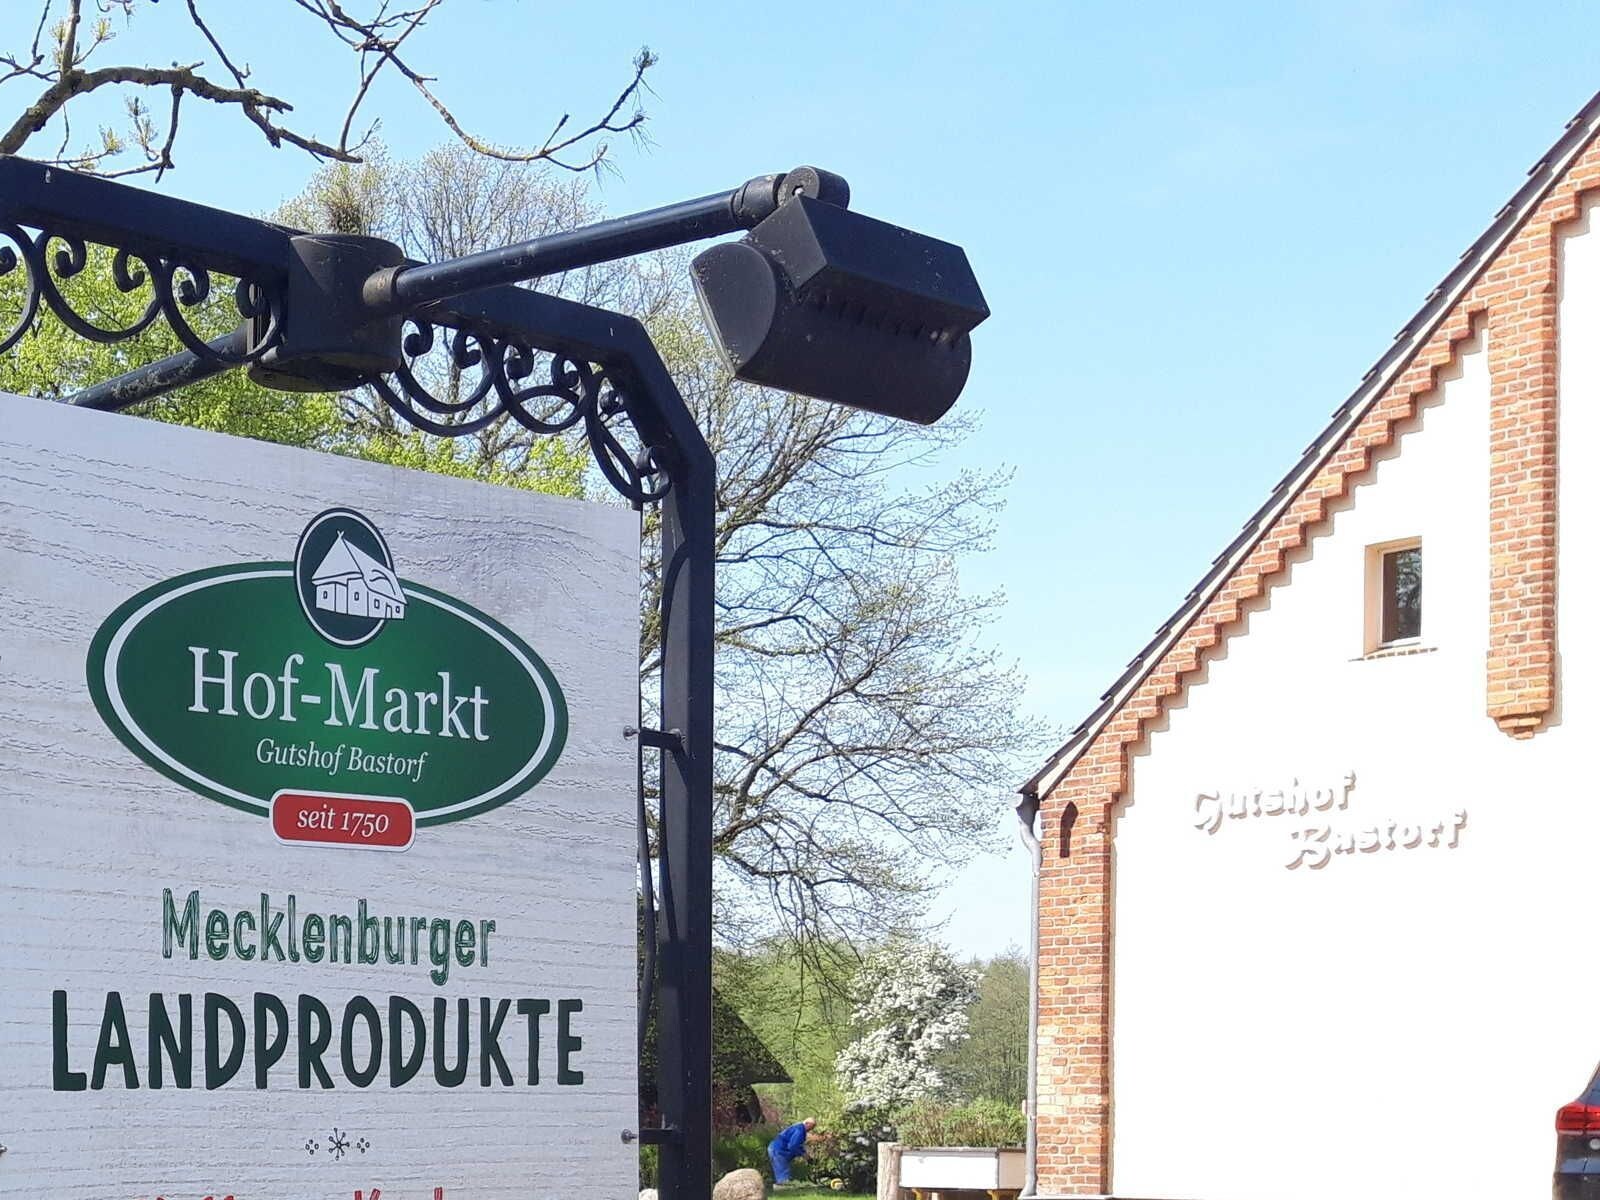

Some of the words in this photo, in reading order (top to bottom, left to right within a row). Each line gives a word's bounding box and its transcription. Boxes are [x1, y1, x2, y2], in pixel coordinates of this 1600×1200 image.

[188, 645, 490, 742] Hof-Markt
[256, 738, 345, 776] Gutshof
[347, 746, 429, 782] Bastorf
[296, 804, 337, 832] seit
[341, 810, 390, 838] 1750
[162, 887, 497, 985] Mecklenburger
[52, 990, 585, 1092] LANDPRODUKTE
